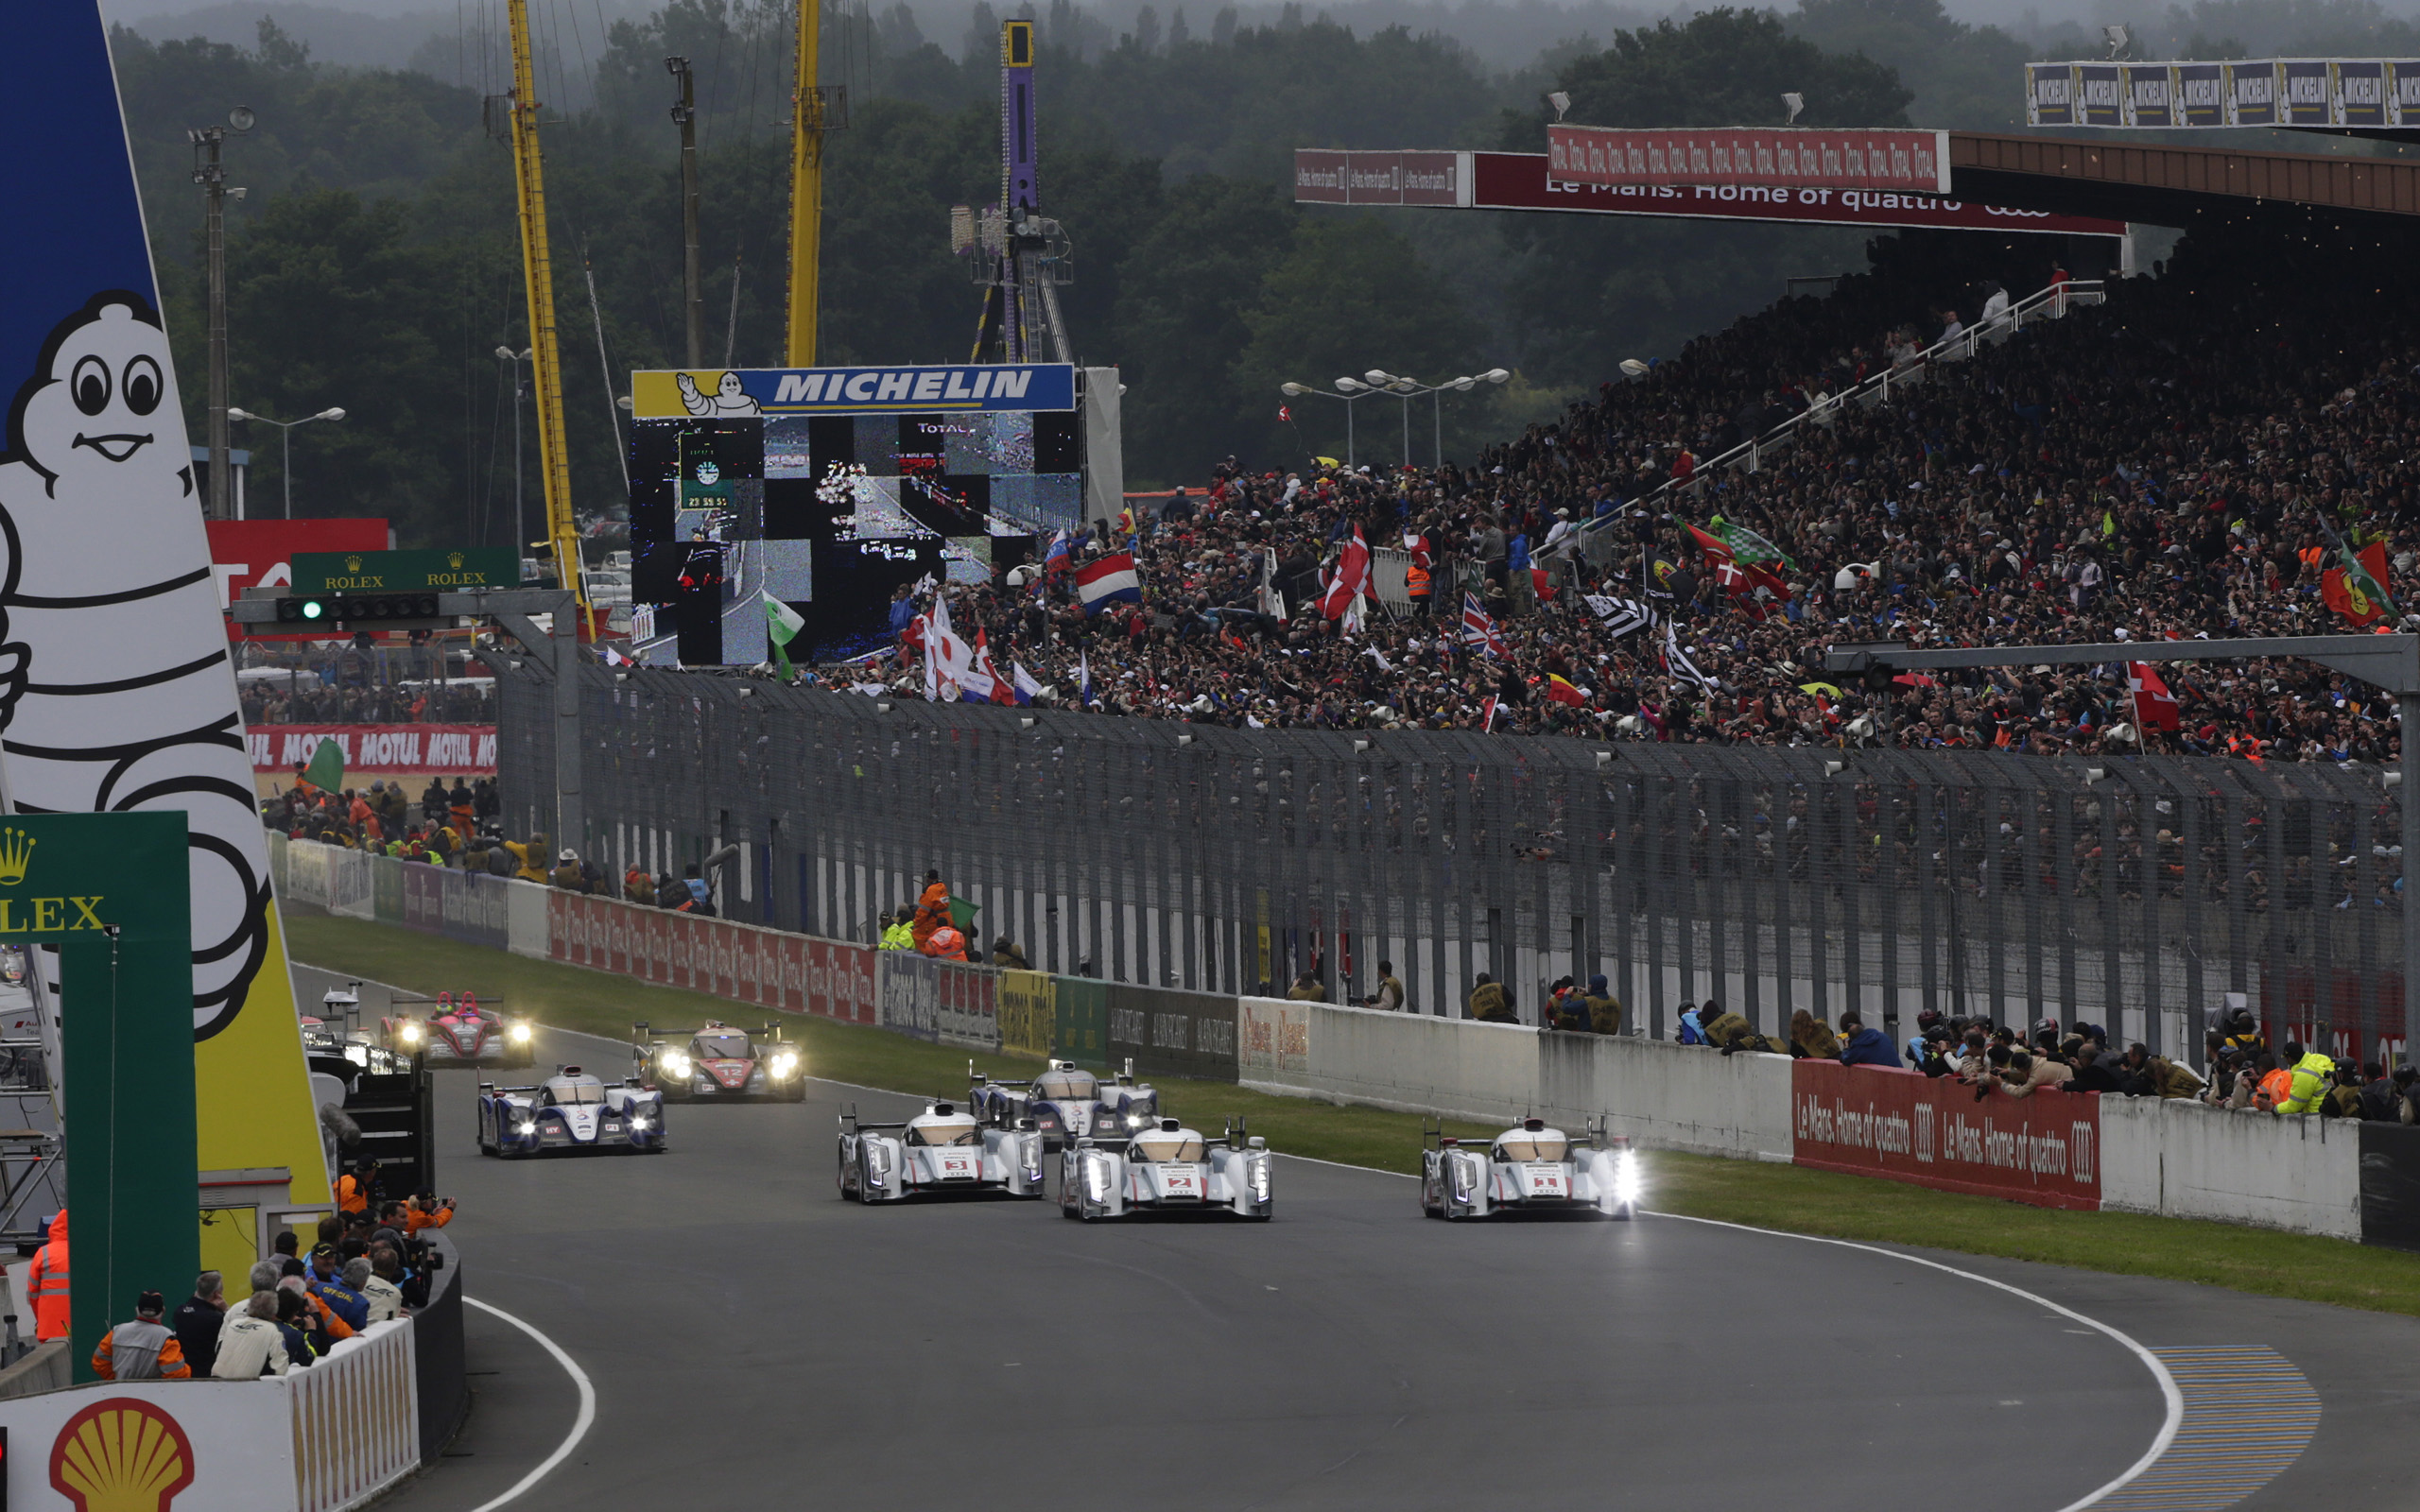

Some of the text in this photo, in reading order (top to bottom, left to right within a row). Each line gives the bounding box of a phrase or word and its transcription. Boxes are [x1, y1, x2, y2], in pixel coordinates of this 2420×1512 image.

[2039, 79, 2069, 104] MICHELIN
[2086, 80, 2118, 105] MICHELIN
[2135, 80, 2168, 106] MICHELIN
[2187, 79, 2220, 106] MICHELIN
[2238, 77, 2272, 104] MICHELIN
[2290, 77, 2325, 103] MICHELIN
[2345, 77, 2380, 104] MICHELIN
[1550, 137, 1935, 179] TOTAL TOTAL TOTAL TOTAL TOTAL TOTAL TOTAL TOTAL TOTAL TOTAL TOTAL TOTAL TOTAL TOTAL TOTAL TOTAL TOTAL TOTAL
[774, 370, 1032, 403] MICHELIN
[325, 572, 486, 589] ROLEX ROLEX
[360, 732, 421, 765] MOTUL
[425, 732, 472, 766] MOTUL
[1798, 1092, 1807, 1139] Le
[1837, 1097, 1861, 1145] Home
[1863, 1102, 1874, 1148] of
[1876, 1109, 1910, 1162] quattro
[1944, 1111, 1954, 1160] Le
[1985, 1117, 2014, 1168] Home
[2017, 1121, 2028, 1170] of
[2030, 1130, 2066, 1185] quattro
[949, 1160, 964, 1170] 3
[1172, 1177, 1187, 1188] 2
[1538, 1177, 1554, 1187] 1
[323, 1286, 354, 1303] OFFICIAL
